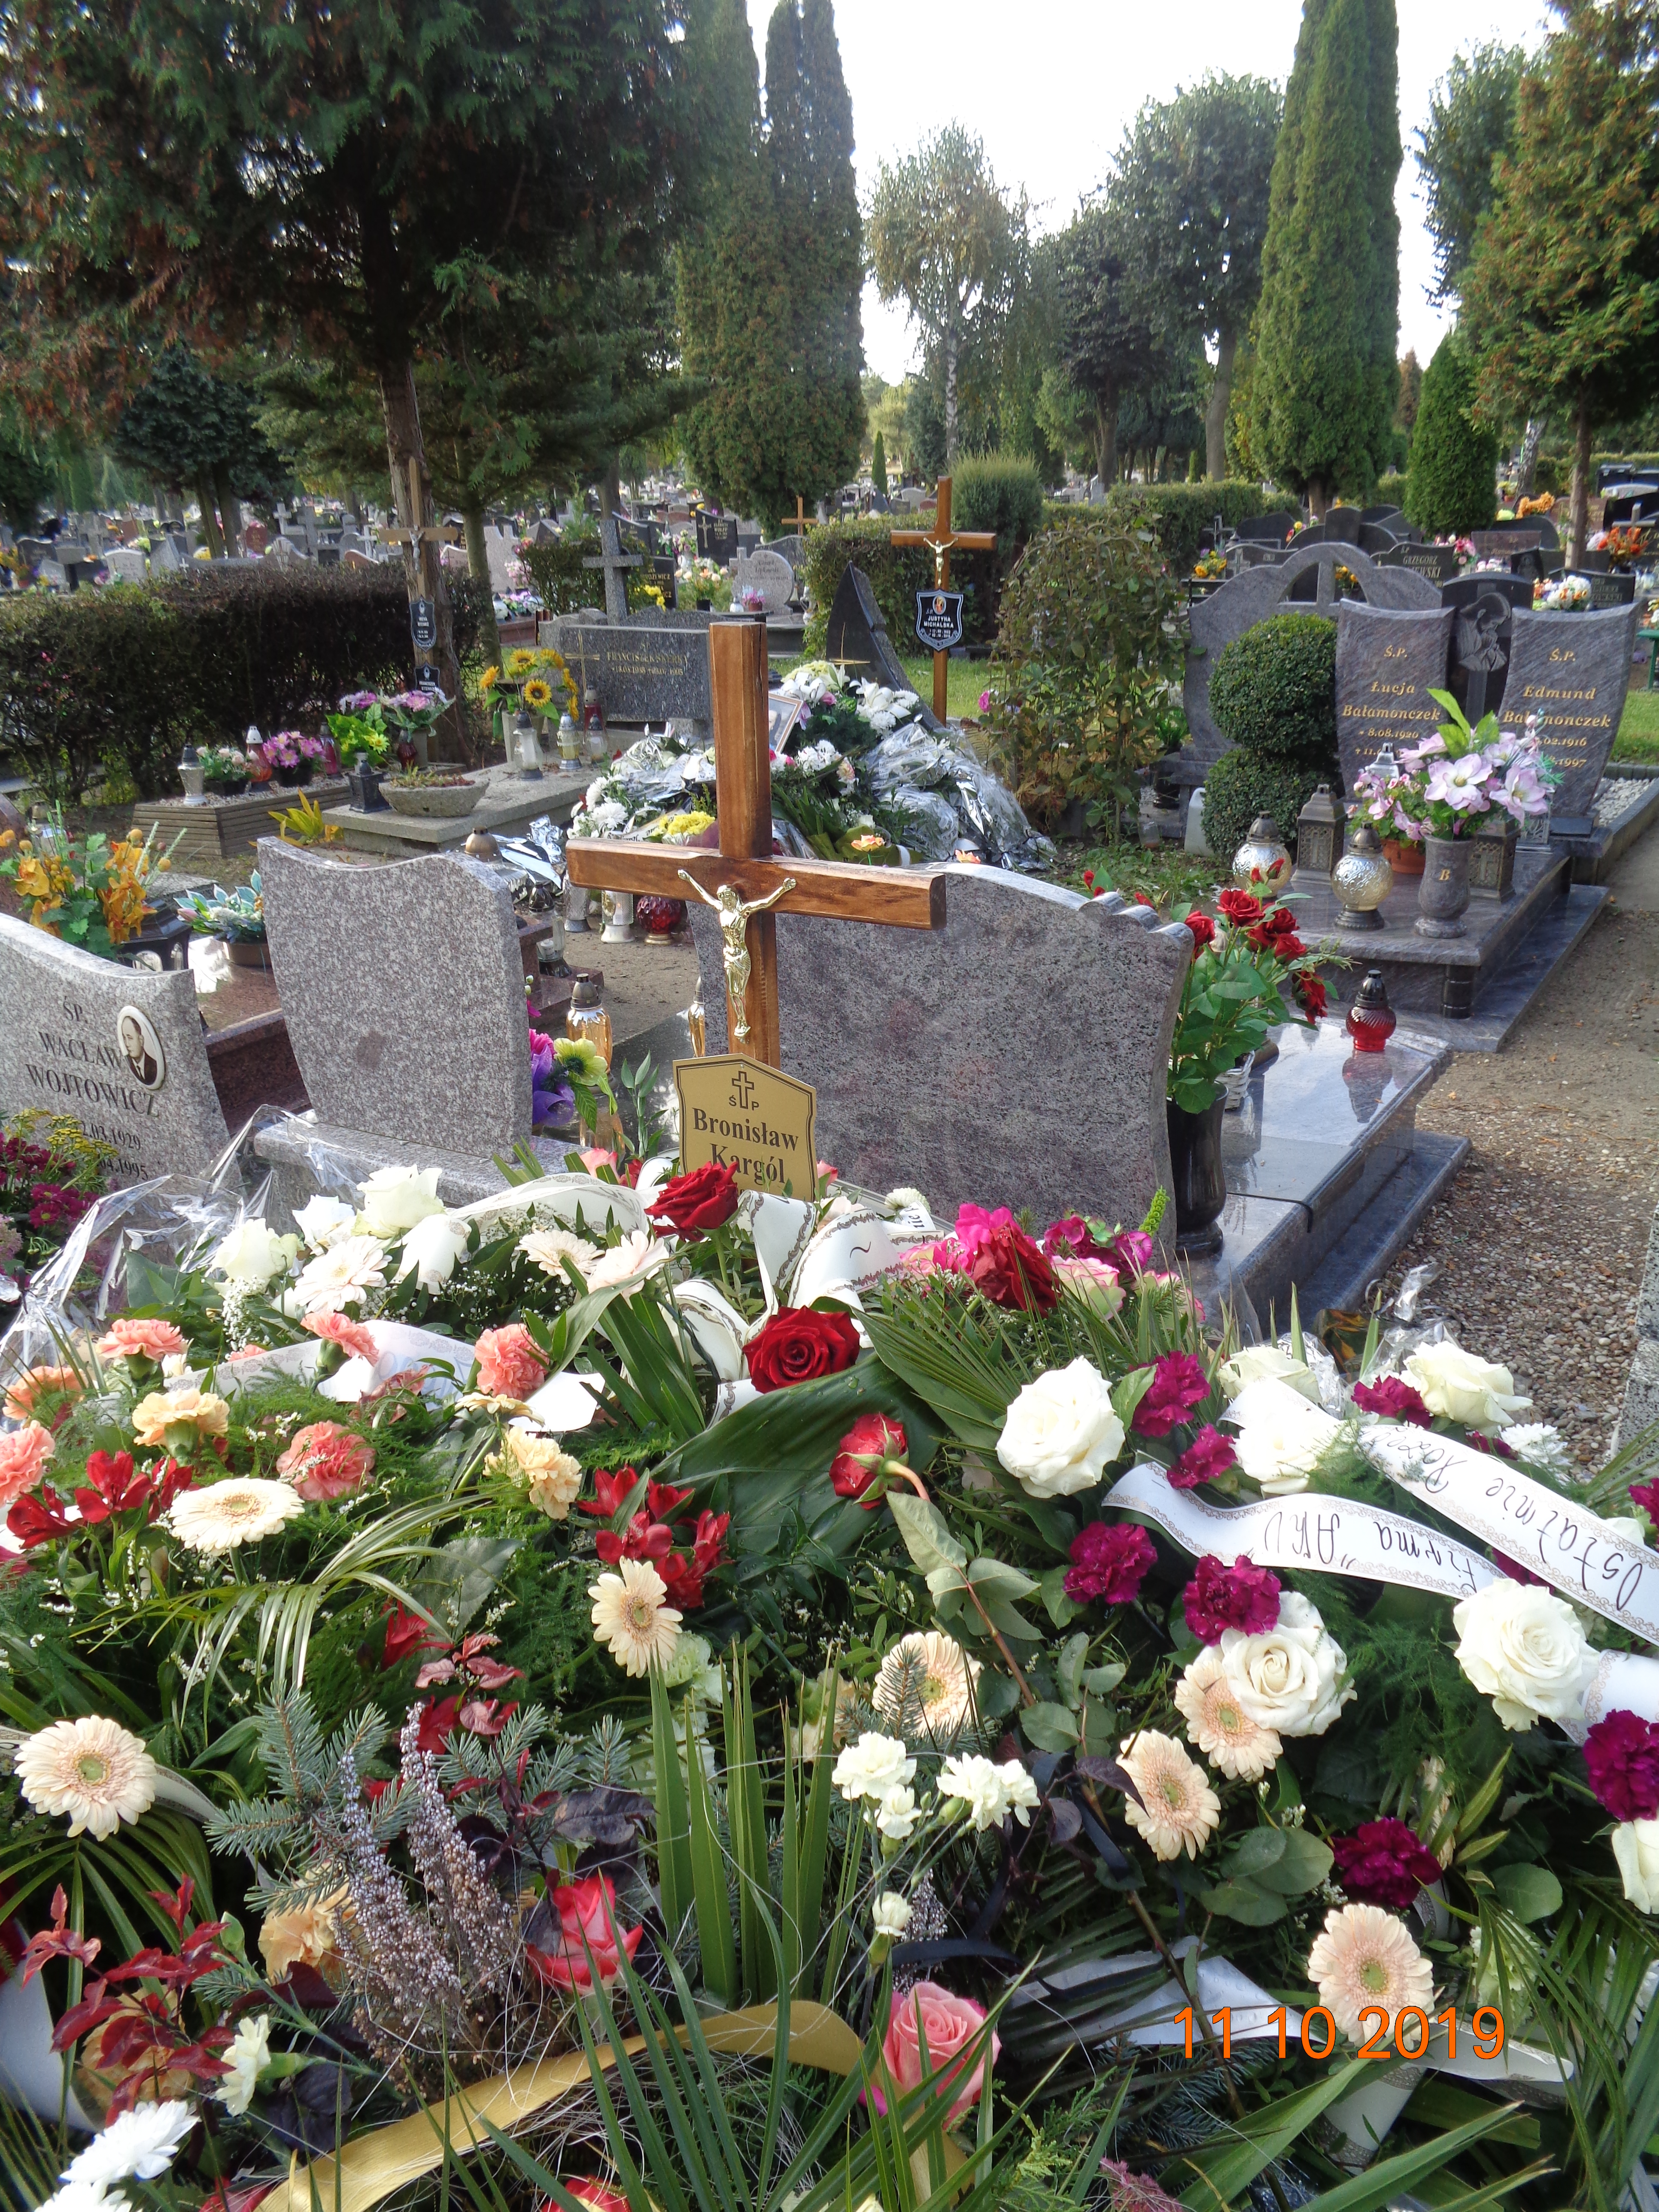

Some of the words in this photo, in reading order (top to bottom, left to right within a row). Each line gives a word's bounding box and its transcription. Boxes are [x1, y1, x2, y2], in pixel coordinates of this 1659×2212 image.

[1403, 556, 1438, 565] GRZEGORZ
[1371, 681, 1416, 696] Łucja
[1523, 686, 1596, 699] Edmund
[1342, 704, 1441, 720] Bałamonczek
[1503, 710, 1611, 727] Bałmonczek
[1439, 869, 1450, 881] B
[692, 1107, 799, 1152] Bronisław
[710, 1143, 785, 1185] Kargól
[1486, 1478, 1643, 1611] Ostatnie
[1373, 1522, 1477, 1594] Firma
